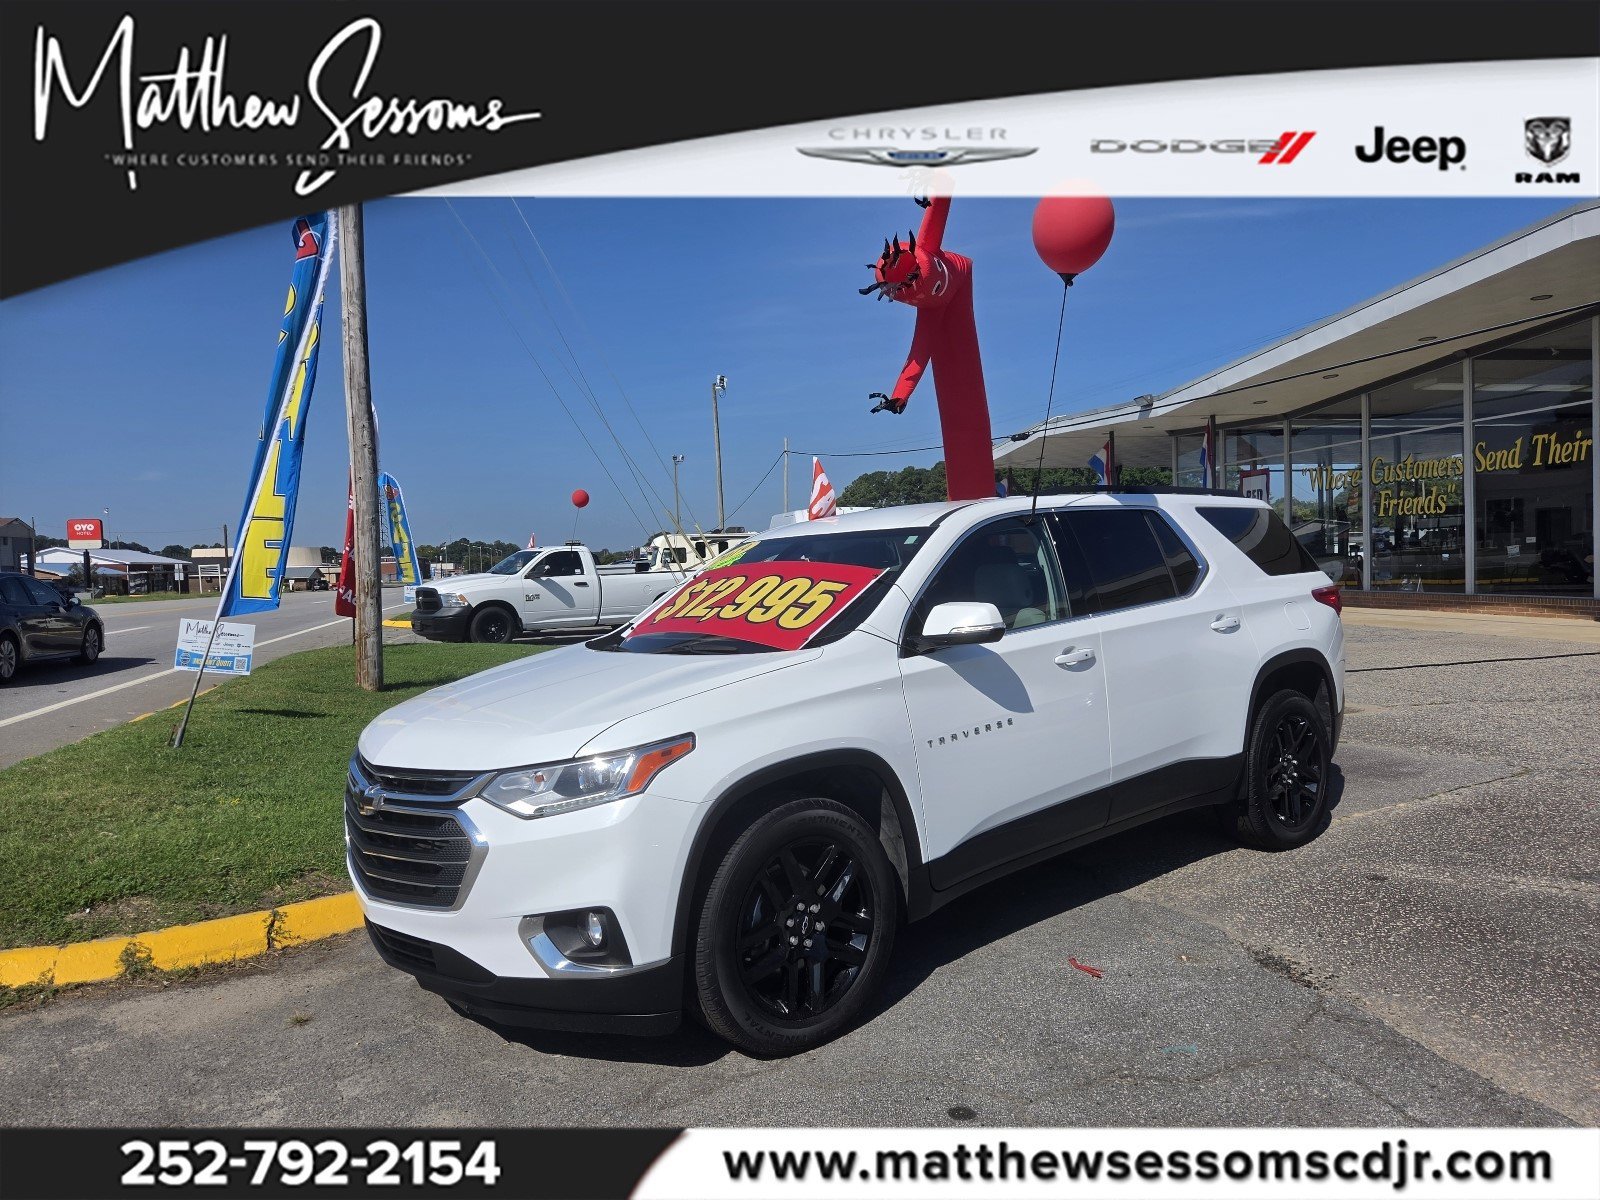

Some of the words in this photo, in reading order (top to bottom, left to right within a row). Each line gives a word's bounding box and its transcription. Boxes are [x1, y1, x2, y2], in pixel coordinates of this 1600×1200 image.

[1371, 453, 1463, 486] Customers
[1475, 436, 1523, 474] Send
[1532, 430, 1593, 467] Their
[74, 523, 95, 531] OYO
[653, 574, 849, 630] $12,995
[927, 717, 1013, 748] TRAVERSE
